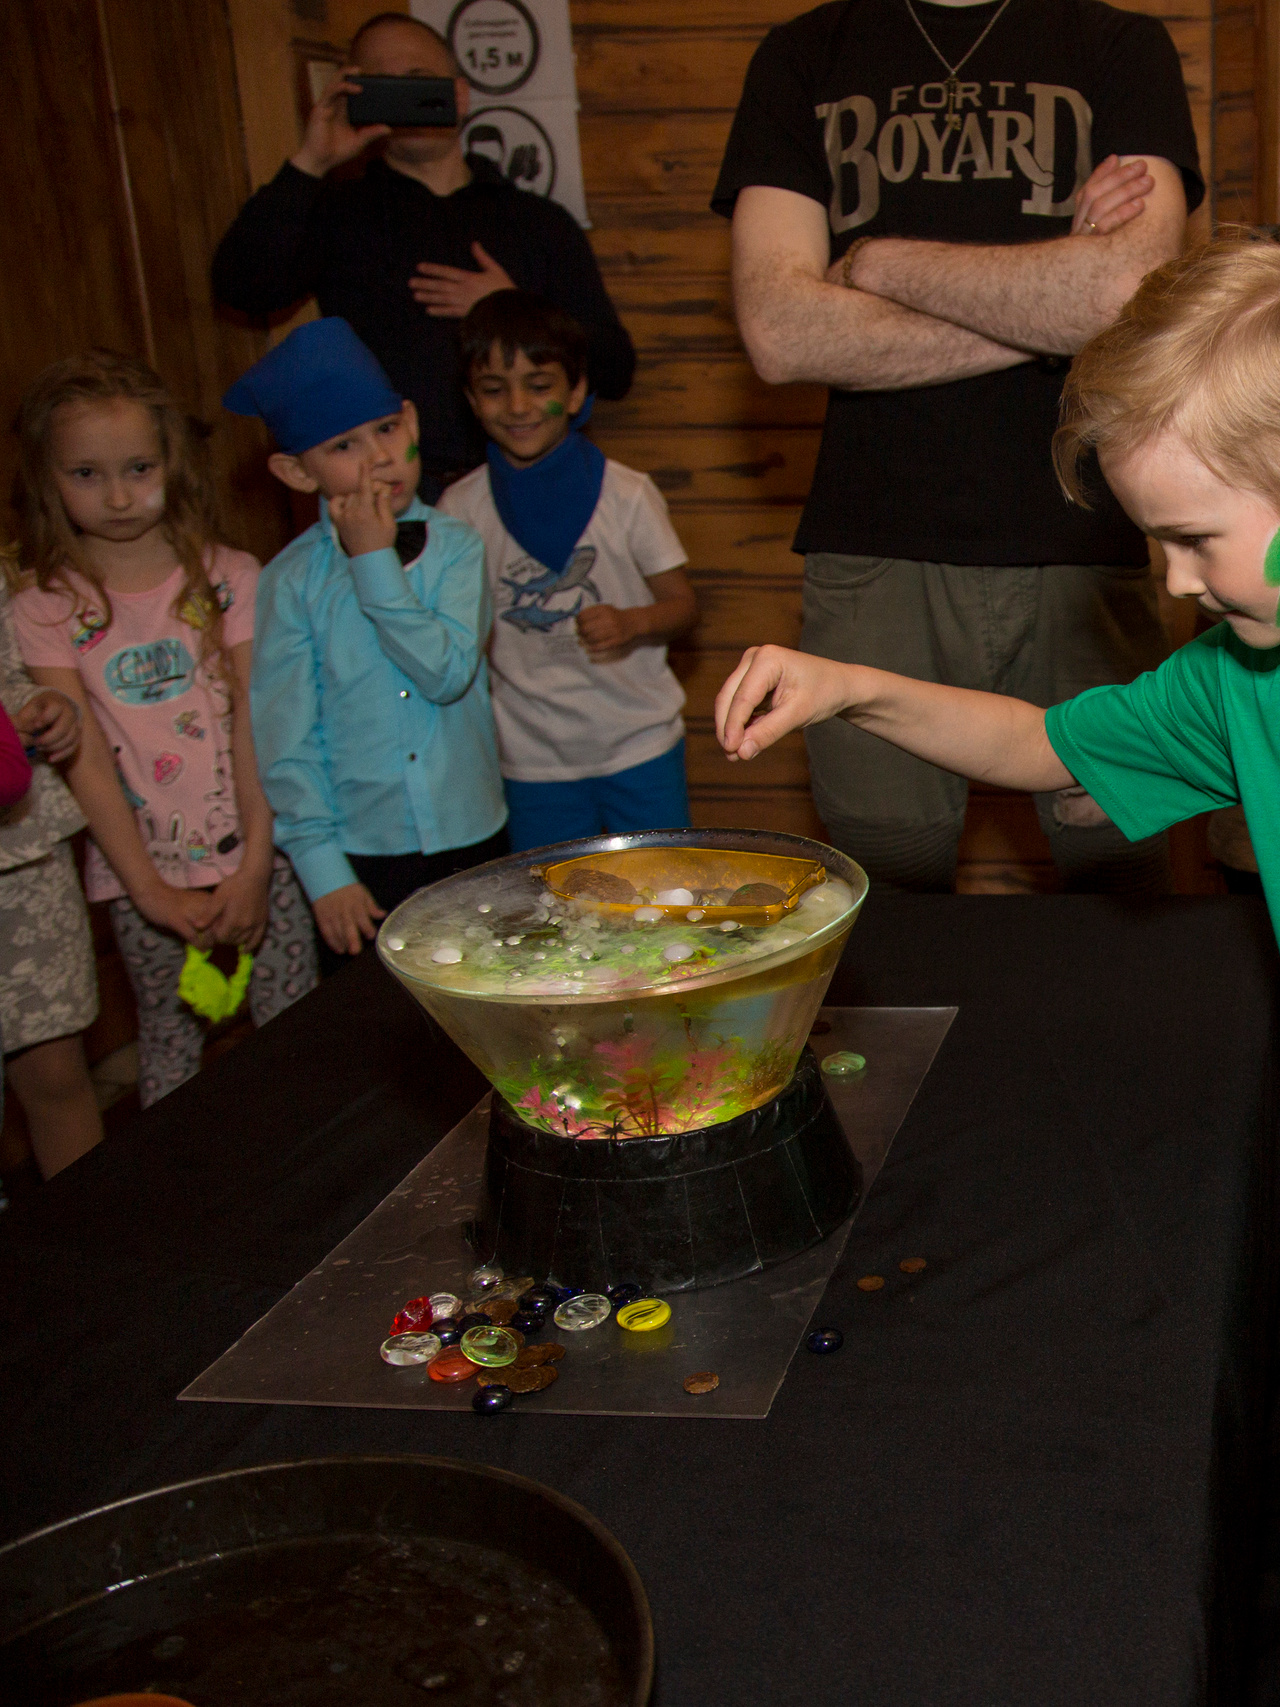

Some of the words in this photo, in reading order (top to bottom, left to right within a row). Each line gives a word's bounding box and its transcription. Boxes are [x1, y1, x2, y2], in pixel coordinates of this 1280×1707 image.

[466, 46, 501, 73] 1,5
[889, 81, 1016, 112] FORT
[814, 82, 1094, 235] BOYARD
